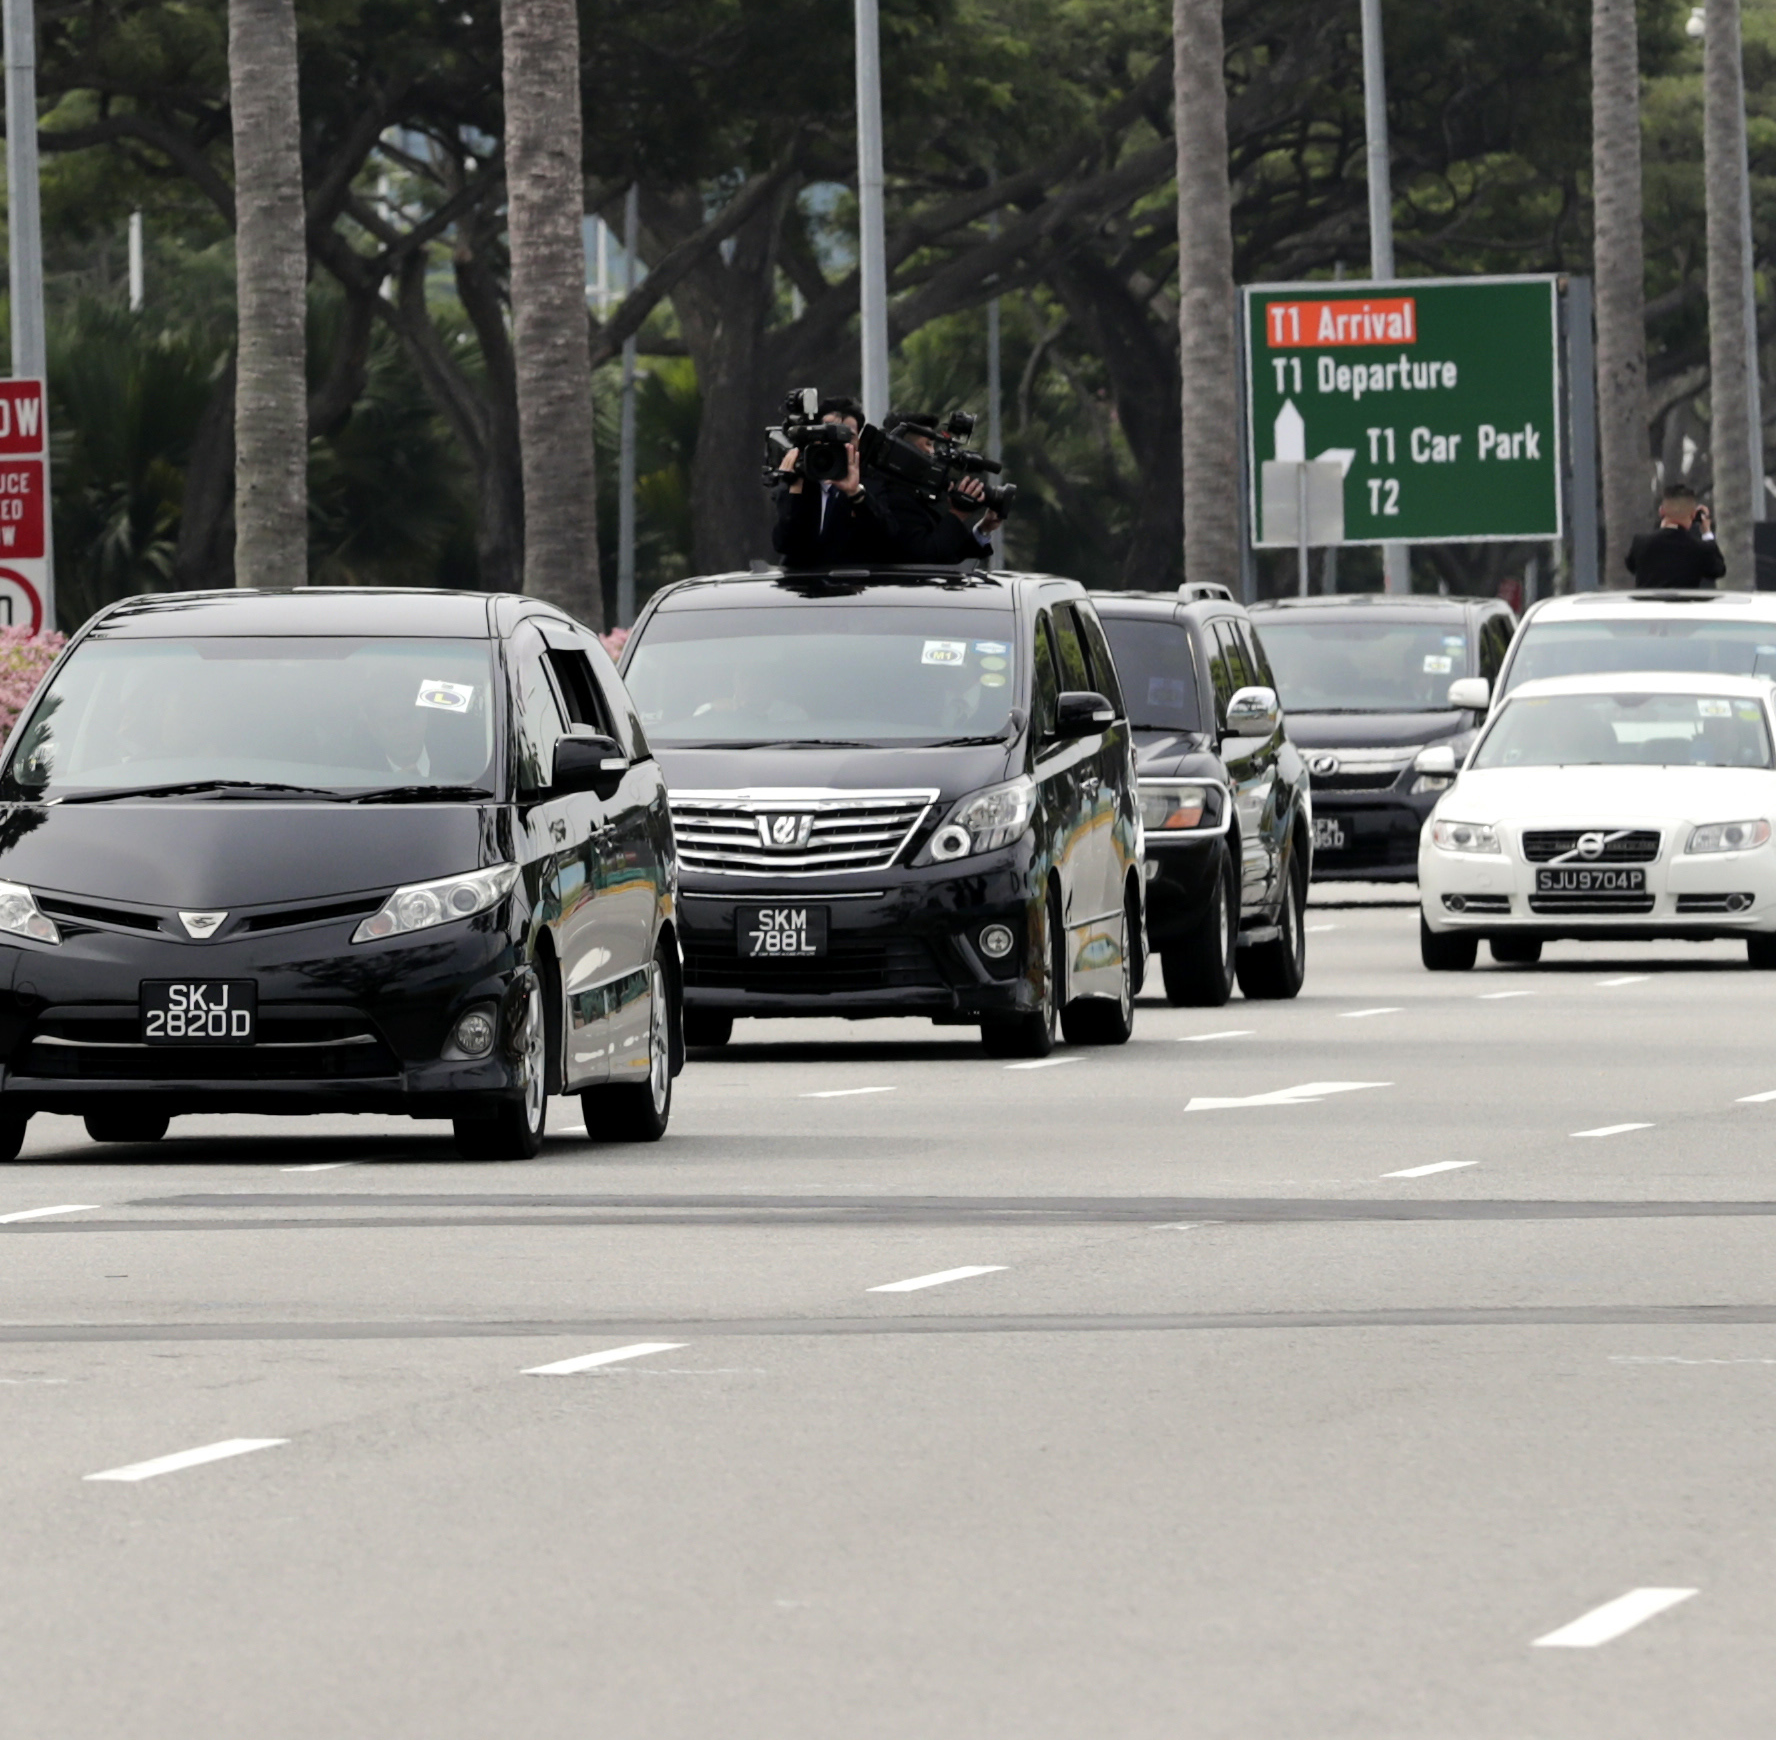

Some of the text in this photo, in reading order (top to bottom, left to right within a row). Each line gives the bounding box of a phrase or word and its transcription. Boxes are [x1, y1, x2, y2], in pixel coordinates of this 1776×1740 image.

[1271, 302, 1412, 342] T1 Arrival
[1272, 353, 1458, 400] T1 Departure
[1367, 422, 1541, 464] T1 Car Park
[1367, 478, 1400, 516] T2
[1540, 870, 1642, 890] SJU9704P
[758, 908, 807, 931] SKM
[748, 930, 817, 953] 788L
[168, 984, 229, 1011] SKJ
[146, 1009, 251, 1037] 2820D
